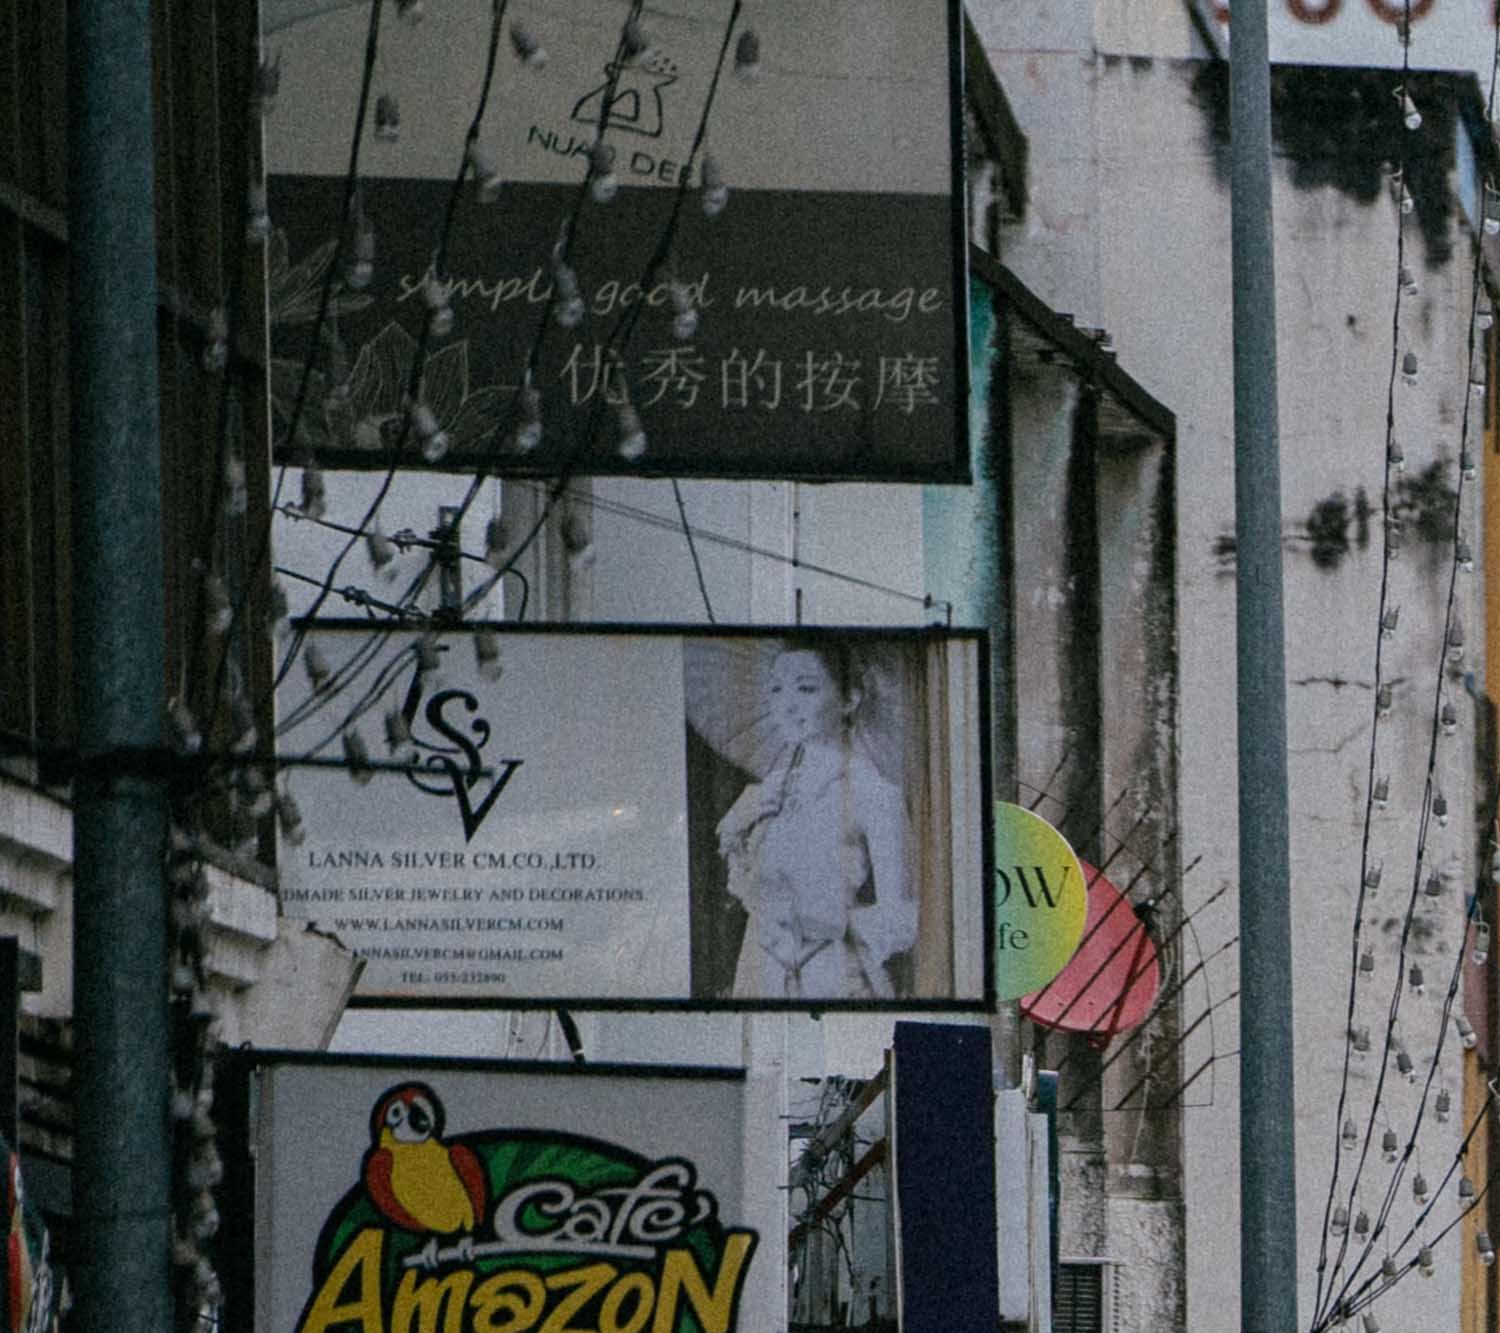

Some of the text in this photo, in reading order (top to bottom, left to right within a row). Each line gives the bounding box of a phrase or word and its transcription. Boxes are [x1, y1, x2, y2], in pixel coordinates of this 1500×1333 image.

[734, 286, 943, 322] massage
[308, 851, 385, 870] LANNA
[391, 851, 466, 870] SILVER
[348, 888, 401, 902] SILVER
[410, 888, 485, 903] JEWELRY
[491, 888, 525, 902] AND
[528, 888, 645, 903] DECORATIONS
